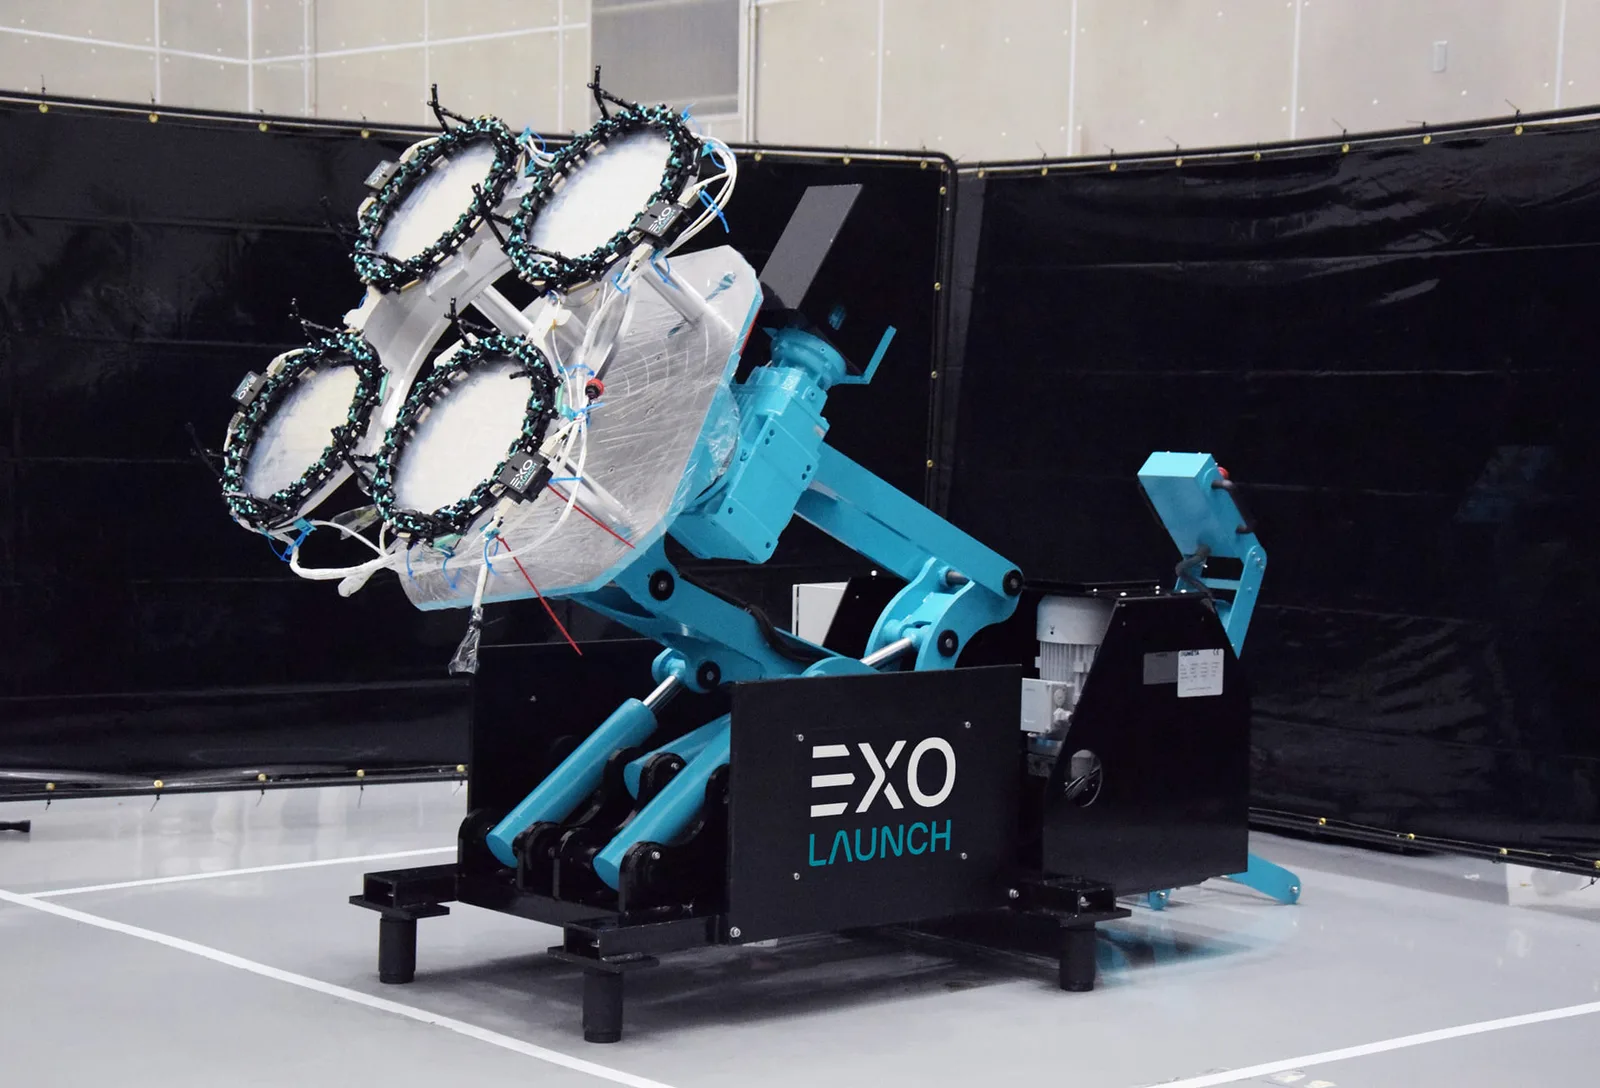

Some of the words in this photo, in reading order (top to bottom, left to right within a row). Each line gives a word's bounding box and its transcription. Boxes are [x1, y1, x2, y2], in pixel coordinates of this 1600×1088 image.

[648, 206, 672, 232] EXO
[510, 459, 533, 488] EXO
[517, 462, 537, 490] LAUNCH
[810, 737, 957, 818] EXO
[808, 819, 952, 867] LAUNCH
